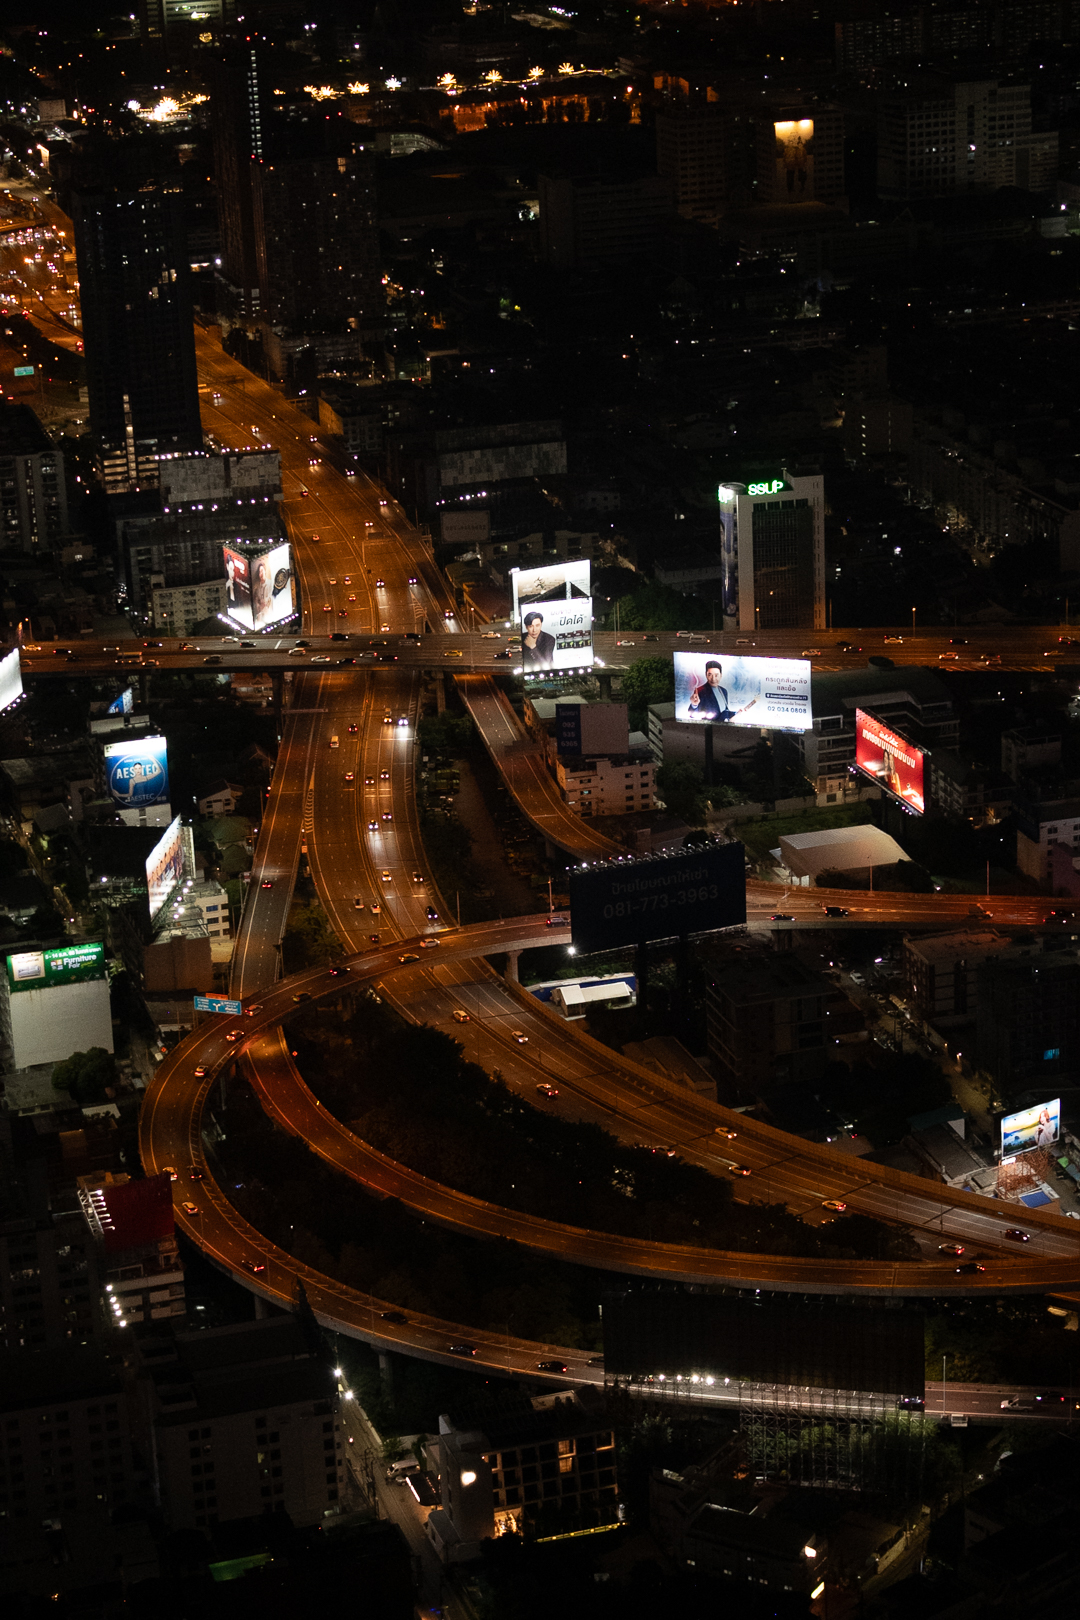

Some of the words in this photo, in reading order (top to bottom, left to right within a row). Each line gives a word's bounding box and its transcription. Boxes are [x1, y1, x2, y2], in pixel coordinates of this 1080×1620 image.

[131, 793, 155, 802] AESTEC
[611, 866, 709, 895] ป้ายโฆษณาให้เช่า
[603, 884, 719, 919] 081-773-3963
[63, 954, 97, 966] Furniture
